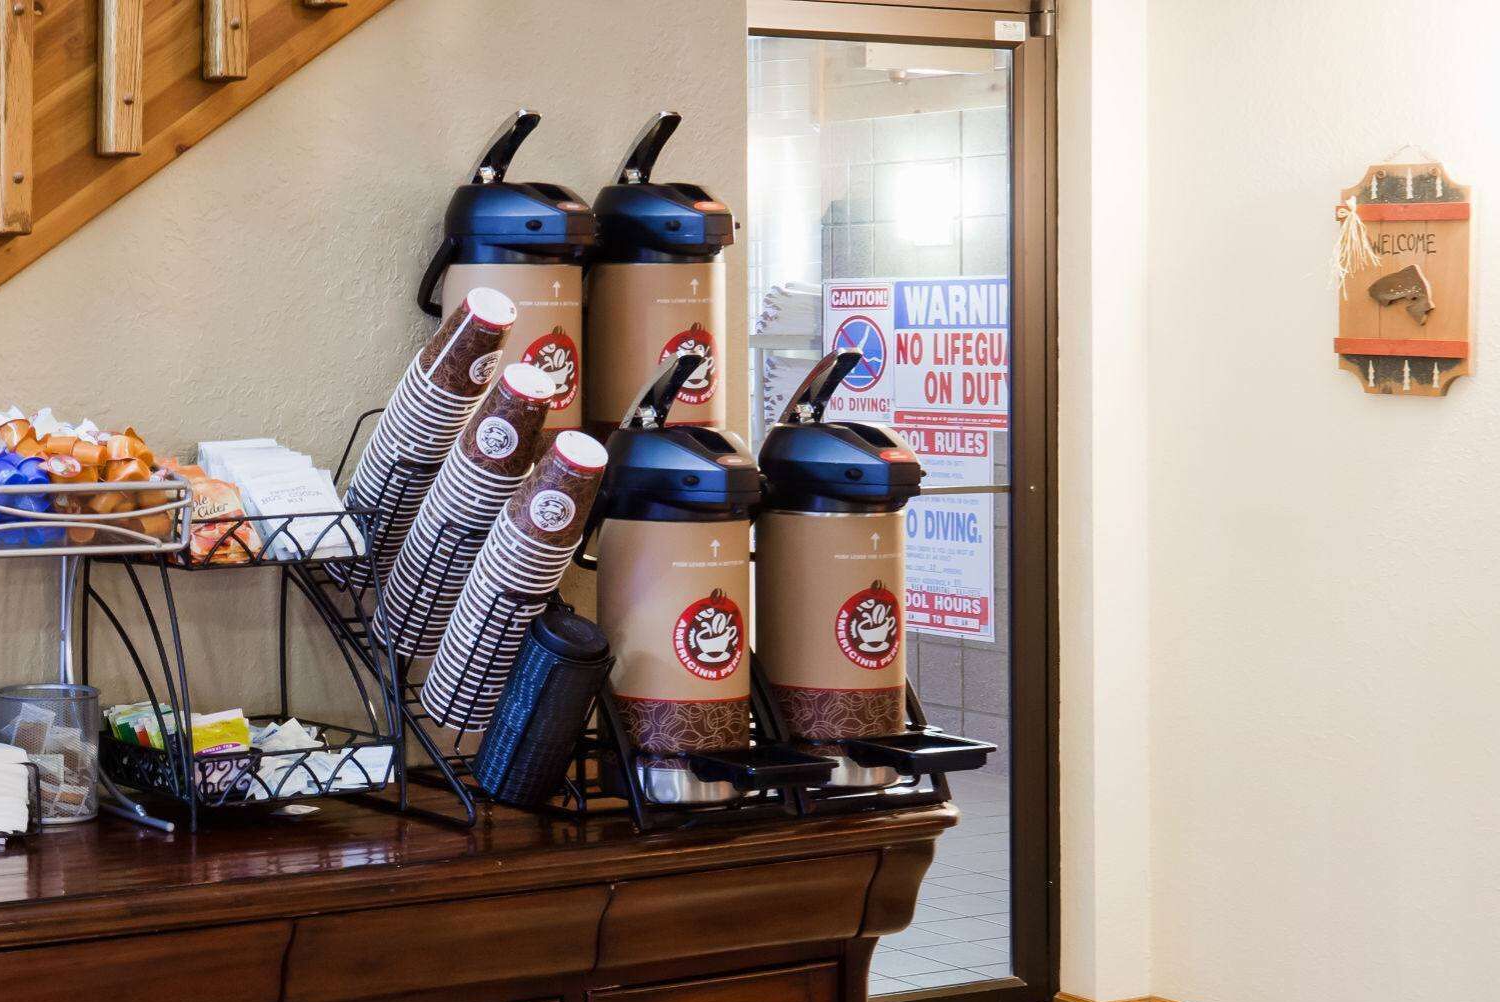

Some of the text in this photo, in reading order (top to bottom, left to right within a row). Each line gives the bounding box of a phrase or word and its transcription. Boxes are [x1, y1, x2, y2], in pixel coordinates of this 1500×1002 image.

[1372, 233, 1437, 255] WELCOME
[832, 290, 888, 306] CAUTION!
[896, 333, 923, 365] NO
[924, 371, 952, 404] ON
[830, 397, 890, 412] NO DIVING!
[934, 431, 985, 454] RULES
[197, 503, 229, 518] Cider
[934, 595, 981, 614] HOURS
